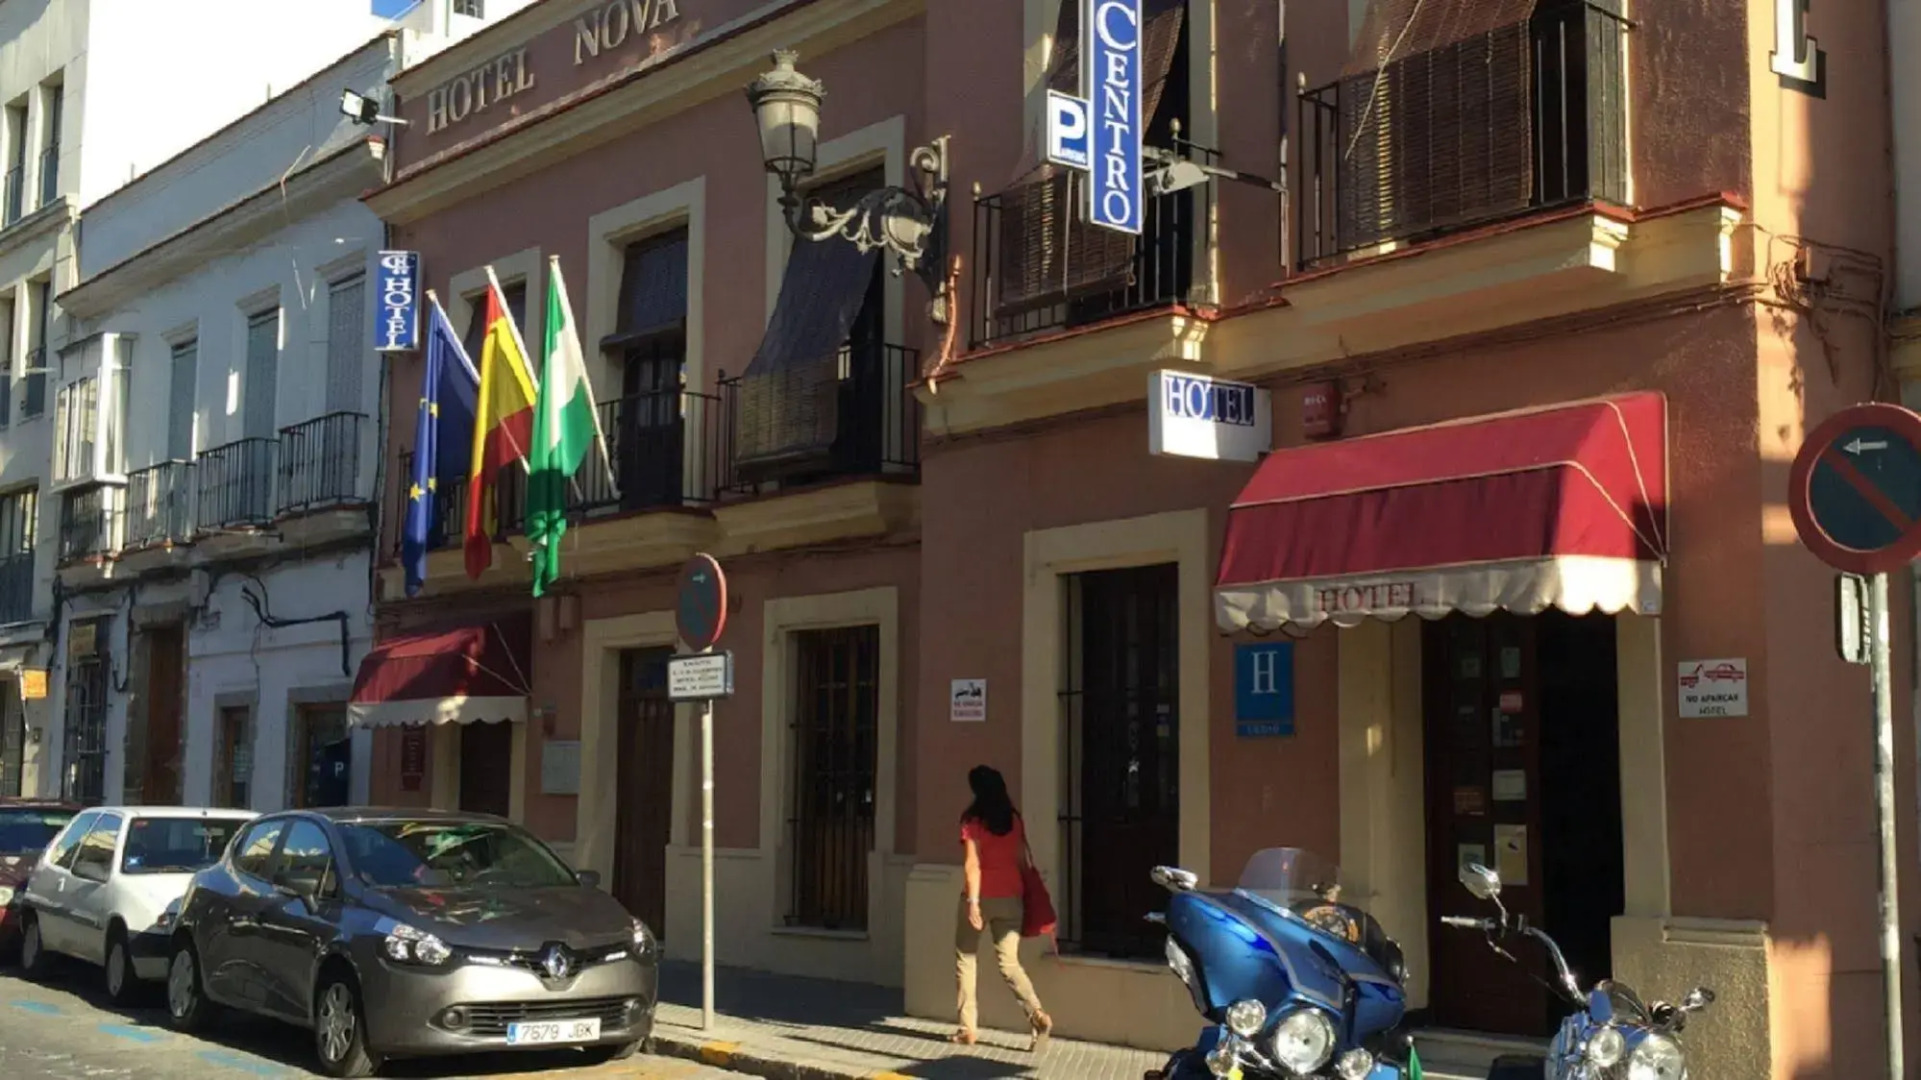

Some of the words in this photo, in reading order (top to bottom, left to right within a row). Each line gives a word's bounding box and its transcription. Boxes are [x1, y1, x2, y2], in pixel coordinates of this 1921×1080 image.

[427, 47, 535, 135] HOTEL
[573, 0, 680, 65] NOVA
[1051, 96, 1086, 158] P
[1096, 2, 1137, 225] CENTRO
[384, 277, 412, 349] HOTEL
[1165, 375, 1254, 425] HOTEL
[1319, 582, 1425, 612] HOTEL
[1251, 651, 1278, 694] H
[1686, 694, 1699, 703] NO
